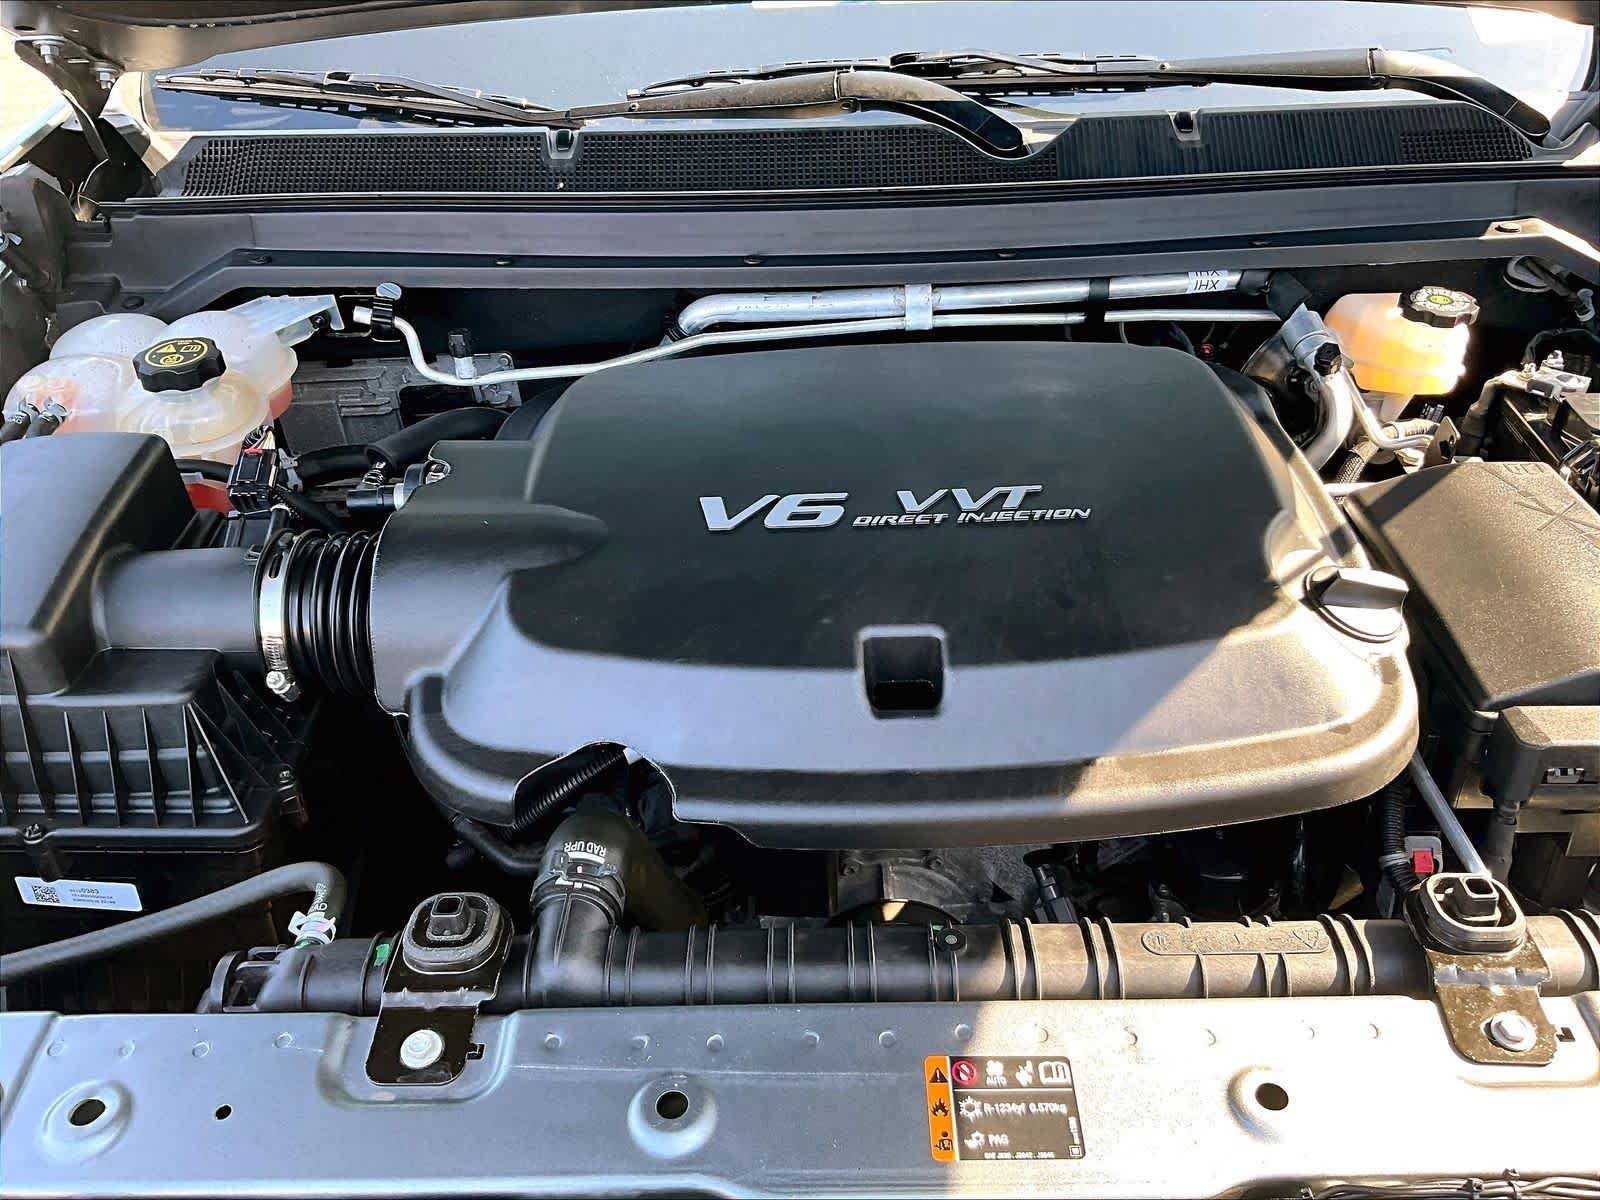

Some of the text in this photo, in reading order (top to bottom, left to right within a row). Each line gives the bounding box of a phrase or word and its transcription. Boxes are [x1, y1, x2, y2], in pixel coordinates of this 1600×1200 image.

[1194, 280, 1219, 290] IHX
[896, 484, 1043, 514] VVT
[700, 493, 848, 531] V6
[852, 507, 1092, 527] DIRECT INJECTION
[564, 841, 606, 857] RAD UPR
